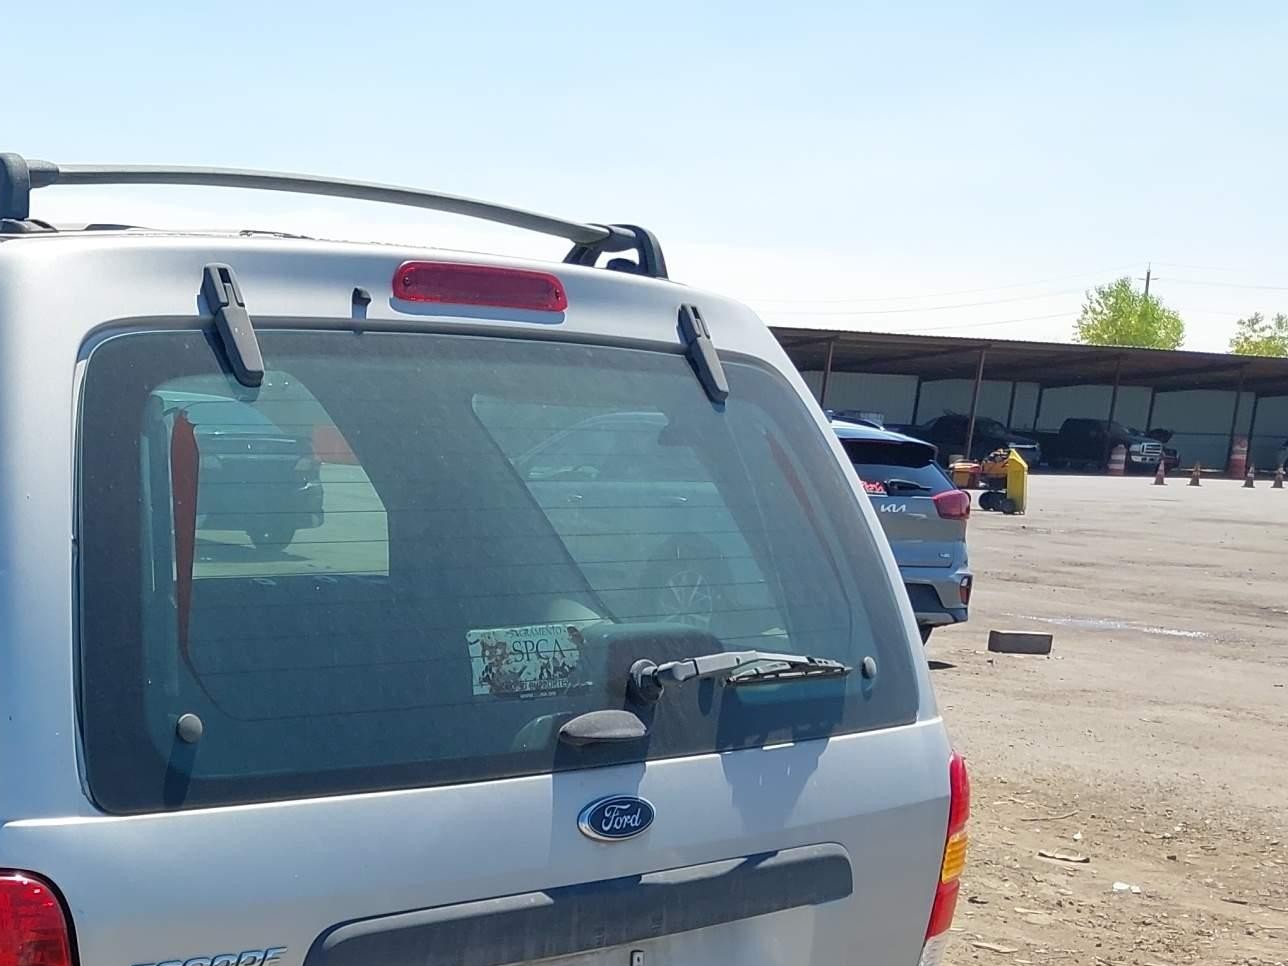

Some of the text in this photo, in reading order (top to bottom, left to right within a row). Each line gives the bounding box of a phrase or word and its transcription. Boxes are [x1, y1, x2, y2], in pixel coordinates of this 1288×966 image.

[880, 503, 907, 513] KIA
[512, 638, 566, 662] SPCA
[601, 803, 642, 831] Ford
